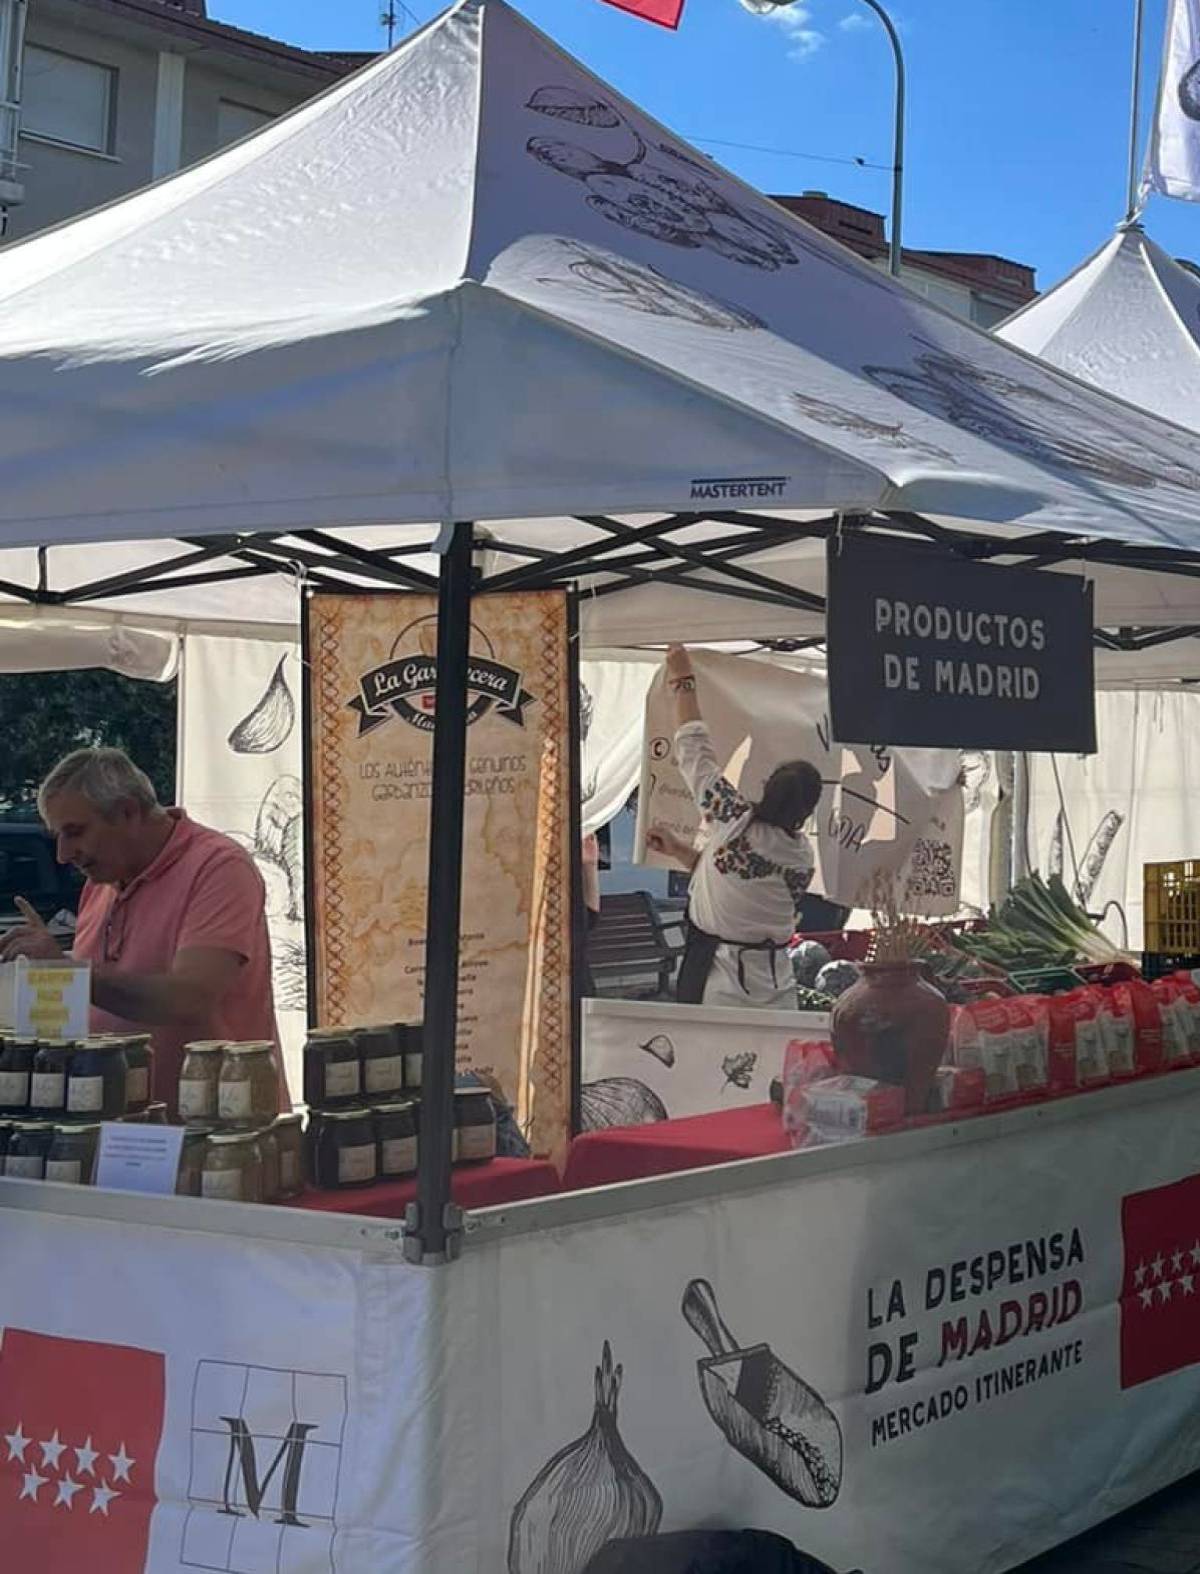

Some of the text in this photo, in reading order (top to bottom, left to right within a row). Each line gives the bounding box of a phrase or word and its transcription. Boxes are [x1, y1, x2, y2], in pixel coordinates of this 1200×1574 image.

[690, 483, 786, 499] MASTERTENT
[875, 599, 1046, 651] PRODUCTOS
[374, 673, 401, 697] La
[884, 654, 1041, 699] DE MADRID
[868, 1227, 1084, 1329] LA DESPENSA
[865, 1279, 1083, 1396] DE MADRID
[871, 1340, 1084, 1447] MERCADO ITINERANTE
[216, 1415, 320, 1528] M
